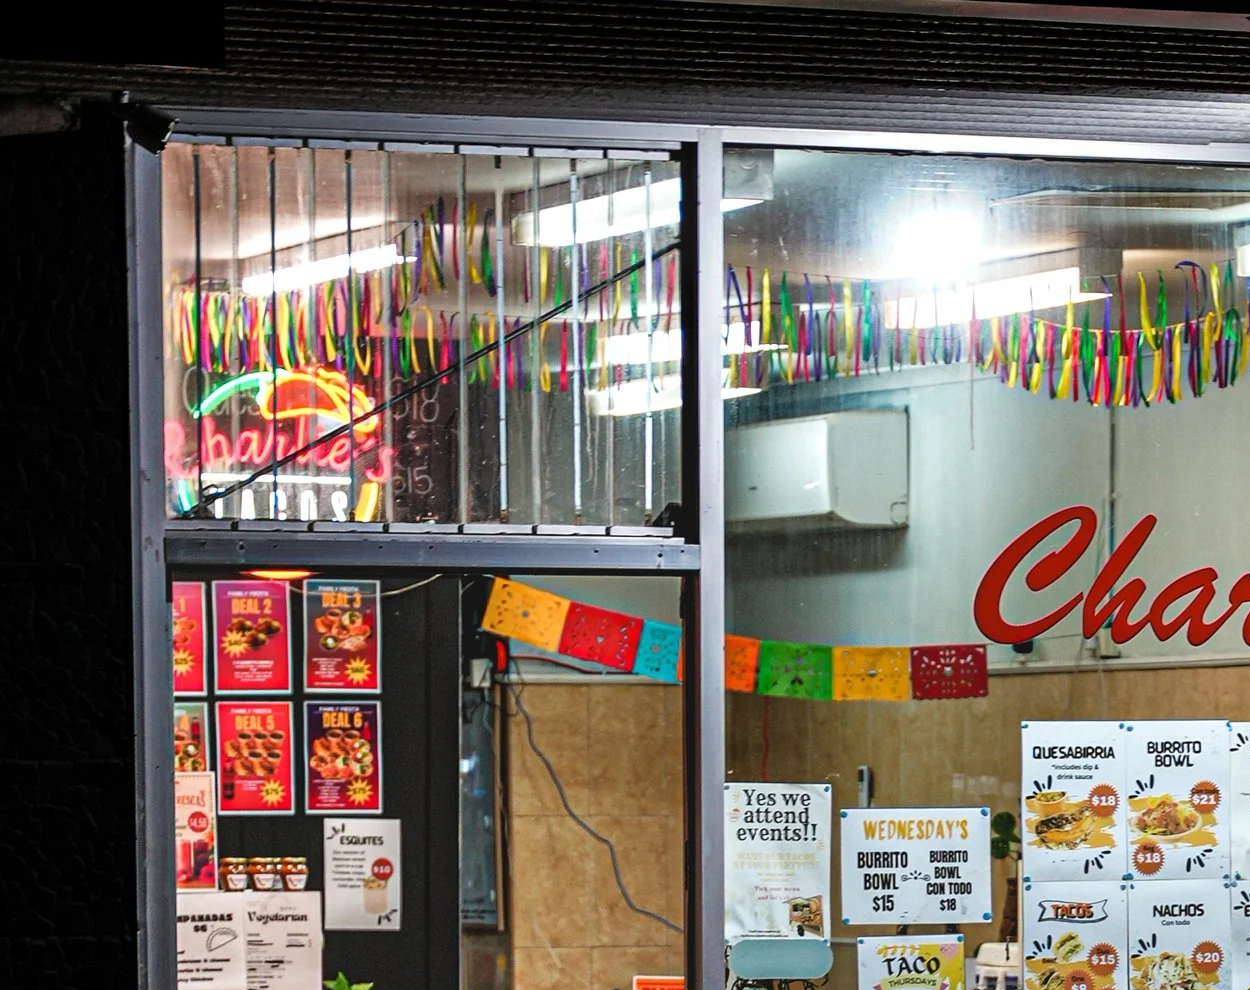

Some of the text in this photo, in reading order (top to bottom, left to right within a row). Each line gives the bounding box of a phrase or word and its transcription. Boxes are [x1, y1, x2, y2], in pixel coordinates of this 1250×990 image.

[232, 598, 272, 614] DEAL 2
[322, 593, 362, 608] DEAL 3
[235, 715, 274, 730] DEAL 5
[323, 712, 362, 728] DEAL 6
[1033, 746, 1115, 759] QUESABIRRIA
[1147, 740, 1202, 754] BURRITO
[1154, 754, 1194, 768] BOWL
[743, 789, 811, 807] Yes we
[1092, 795, 1116, 806] $18
[1192, 794, 1216, 805] $21
[744, 807, 810, 824] attend
[737, 823, 817, 842] events!!
[864, 819, 968, 841] WEDNESDAY'S
[340, 835, 383, 845] ESQUITES
[857, 851, 908, 869] BURRITO
[930, 850, 968, 863] BURRITO
[1137, 852, 1160, 864] $18
[935, 866, 961, 879] BOWL
[864, 873, 899, 891] BOWL
[927, 882, 972, 895] CON TODO
[873, 894, 894, 912] $15
[940, 898, 956, 911] $18
[1051, 903, 1093, 919] TACOS
[1153, 904, 1204, 918] NACHOS
[1091, 954, 1115, 966] $15
[1196, 952, 1219, 963] $20
[882, 956, 940, 978] TACO
[888, 977, 936, 988] THURSDAYS
